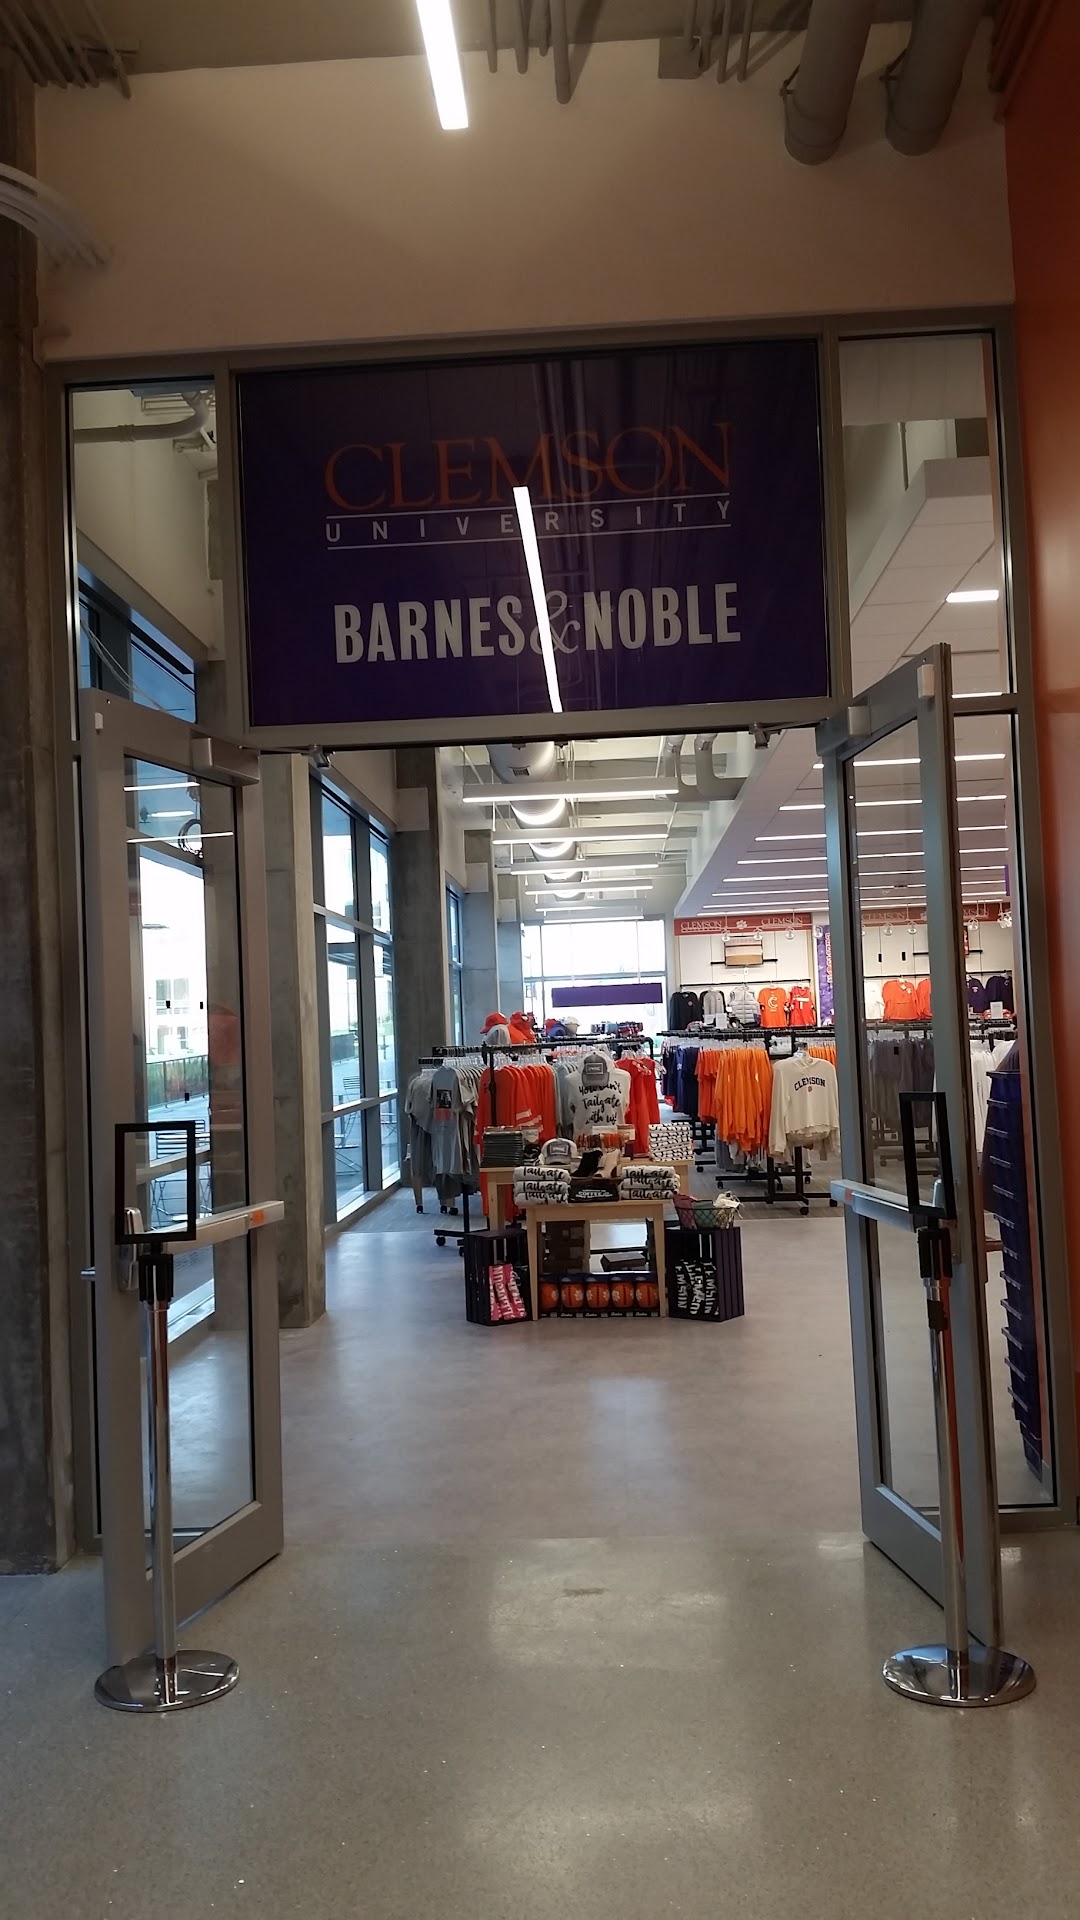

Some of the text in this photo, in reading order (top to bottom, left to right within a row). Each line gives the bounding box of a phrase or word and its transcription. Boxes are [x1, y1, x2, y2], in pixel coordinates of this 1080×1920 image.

[325, 422, 732, 511] CLEMSON
[326, 500, 731, 543] UNIVERSITY
[334, 595, 528, 665] BARNES
[584, 582, 741, 651] NOBLE
[761, 917, 803, 926] CLEMSON
[862, 912, 905, 920] CLEMSON
[680, 920, 722, 929] CLEMSON
[794, 1077, 826, 1091] CLEMSON
[581, 1094, 621, 1113] Tailgate
